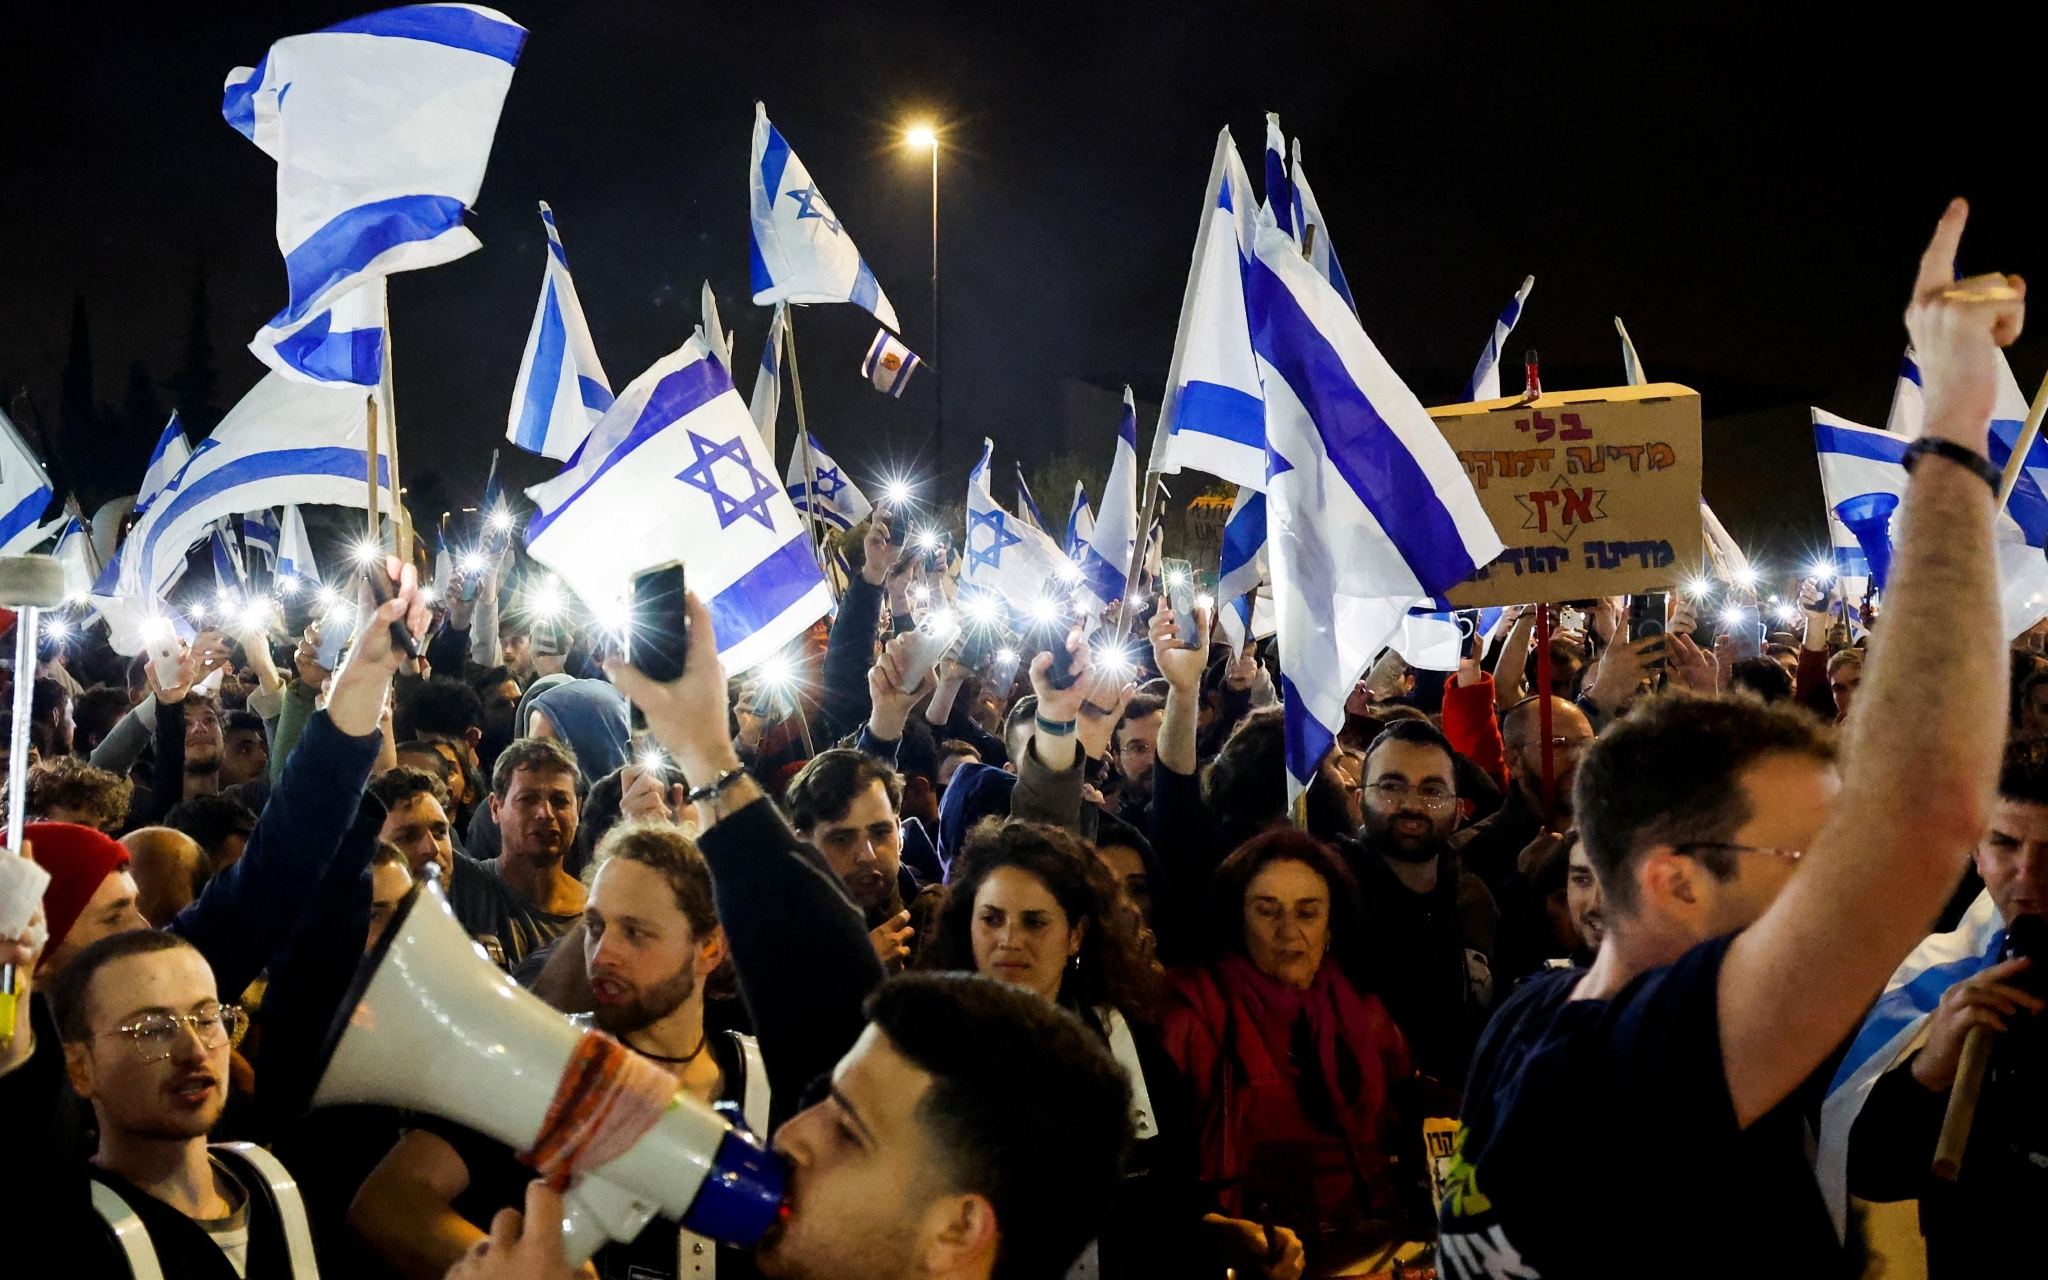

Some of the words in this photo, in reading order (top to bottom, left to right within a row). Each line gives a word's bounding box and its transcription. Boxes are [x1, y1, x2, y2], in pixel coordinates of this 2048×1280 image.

[1515, 411, 1593, 443] בלי
[1459, 448, 1555, 489] דמוקר
[1567, 442, 1676, 475] מדינה
[1530, 487, 1594, 533] אין
[1584, 540, 1676, 570] מדינה
[1427, 1131, 1458, 1157] קרן
